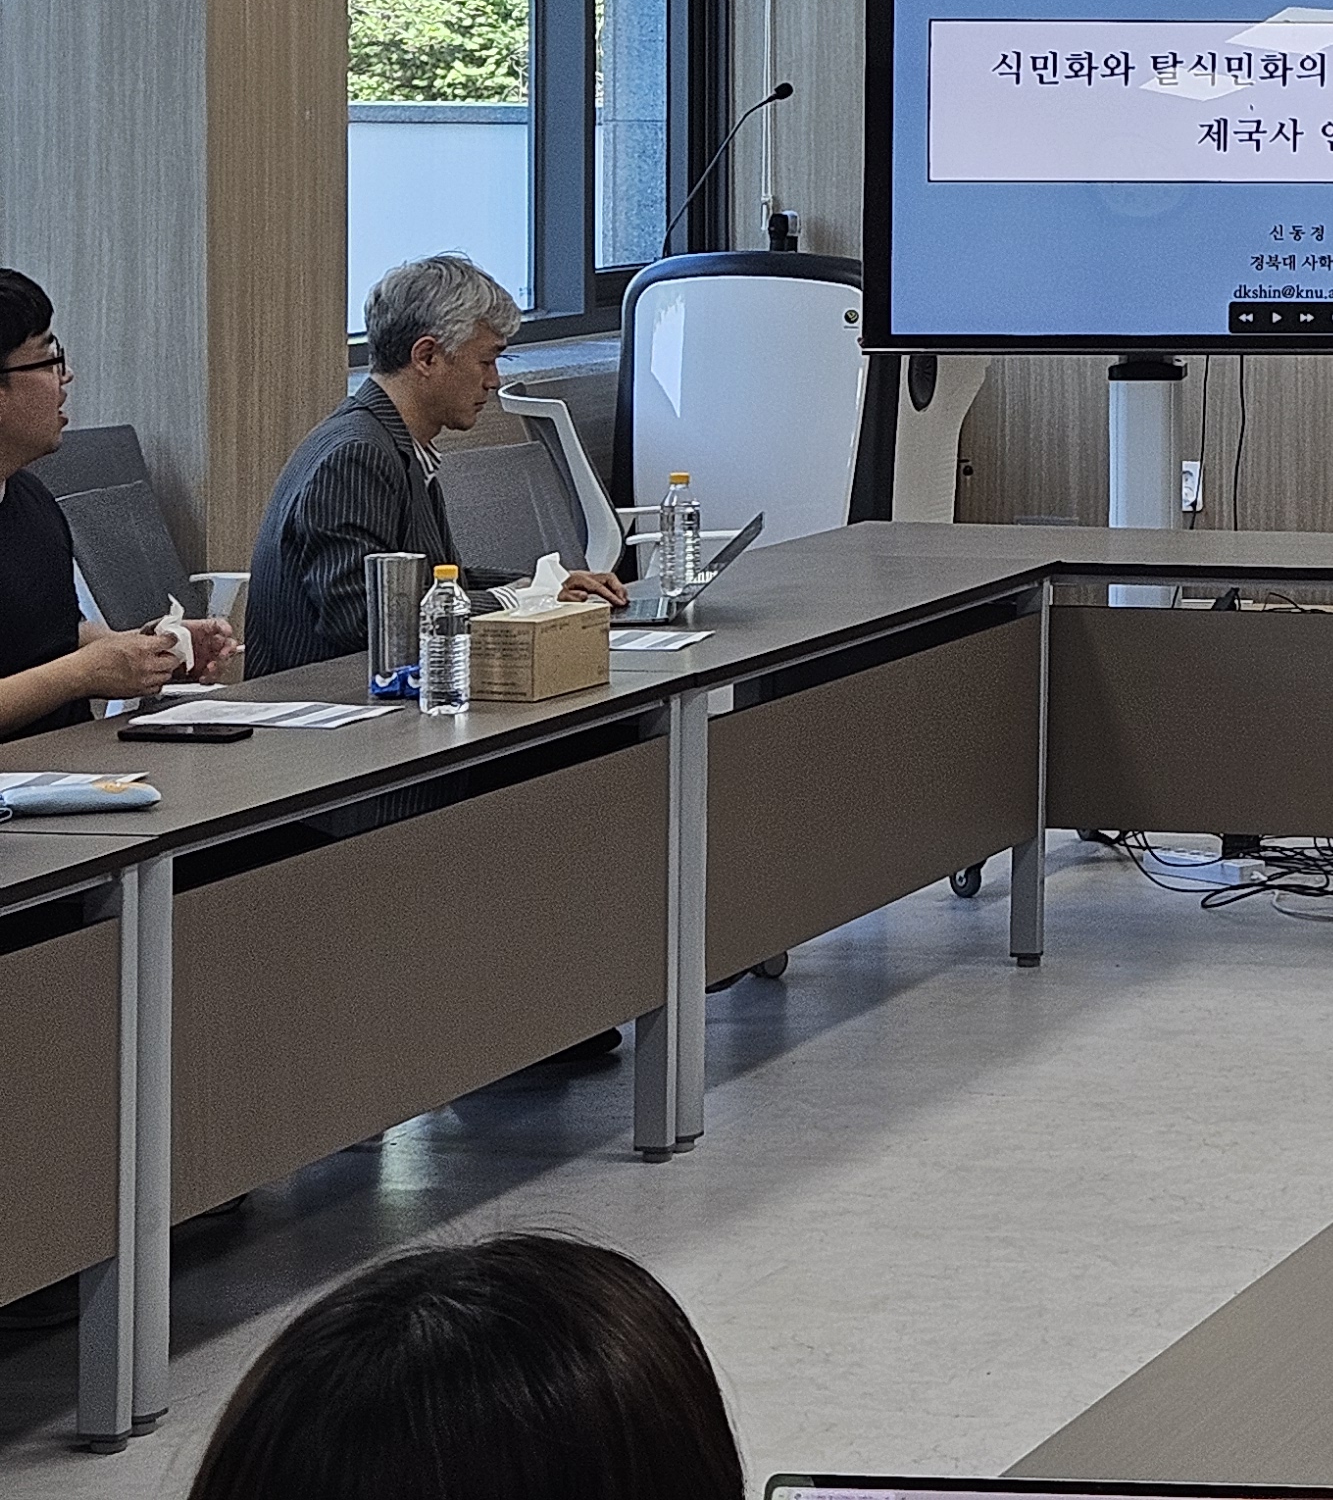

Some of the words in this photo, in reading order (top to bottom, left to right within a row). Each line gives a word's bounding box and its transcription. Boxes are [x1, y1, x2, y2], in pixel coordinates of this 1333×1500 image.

[991, 49, 1136, 87] 식민화와
[1150, 51, 1327, 88] 탈식민화의
[1197, 117, 1305, 153] 제국사
[1250, 254, 1296, 272] 경북대
